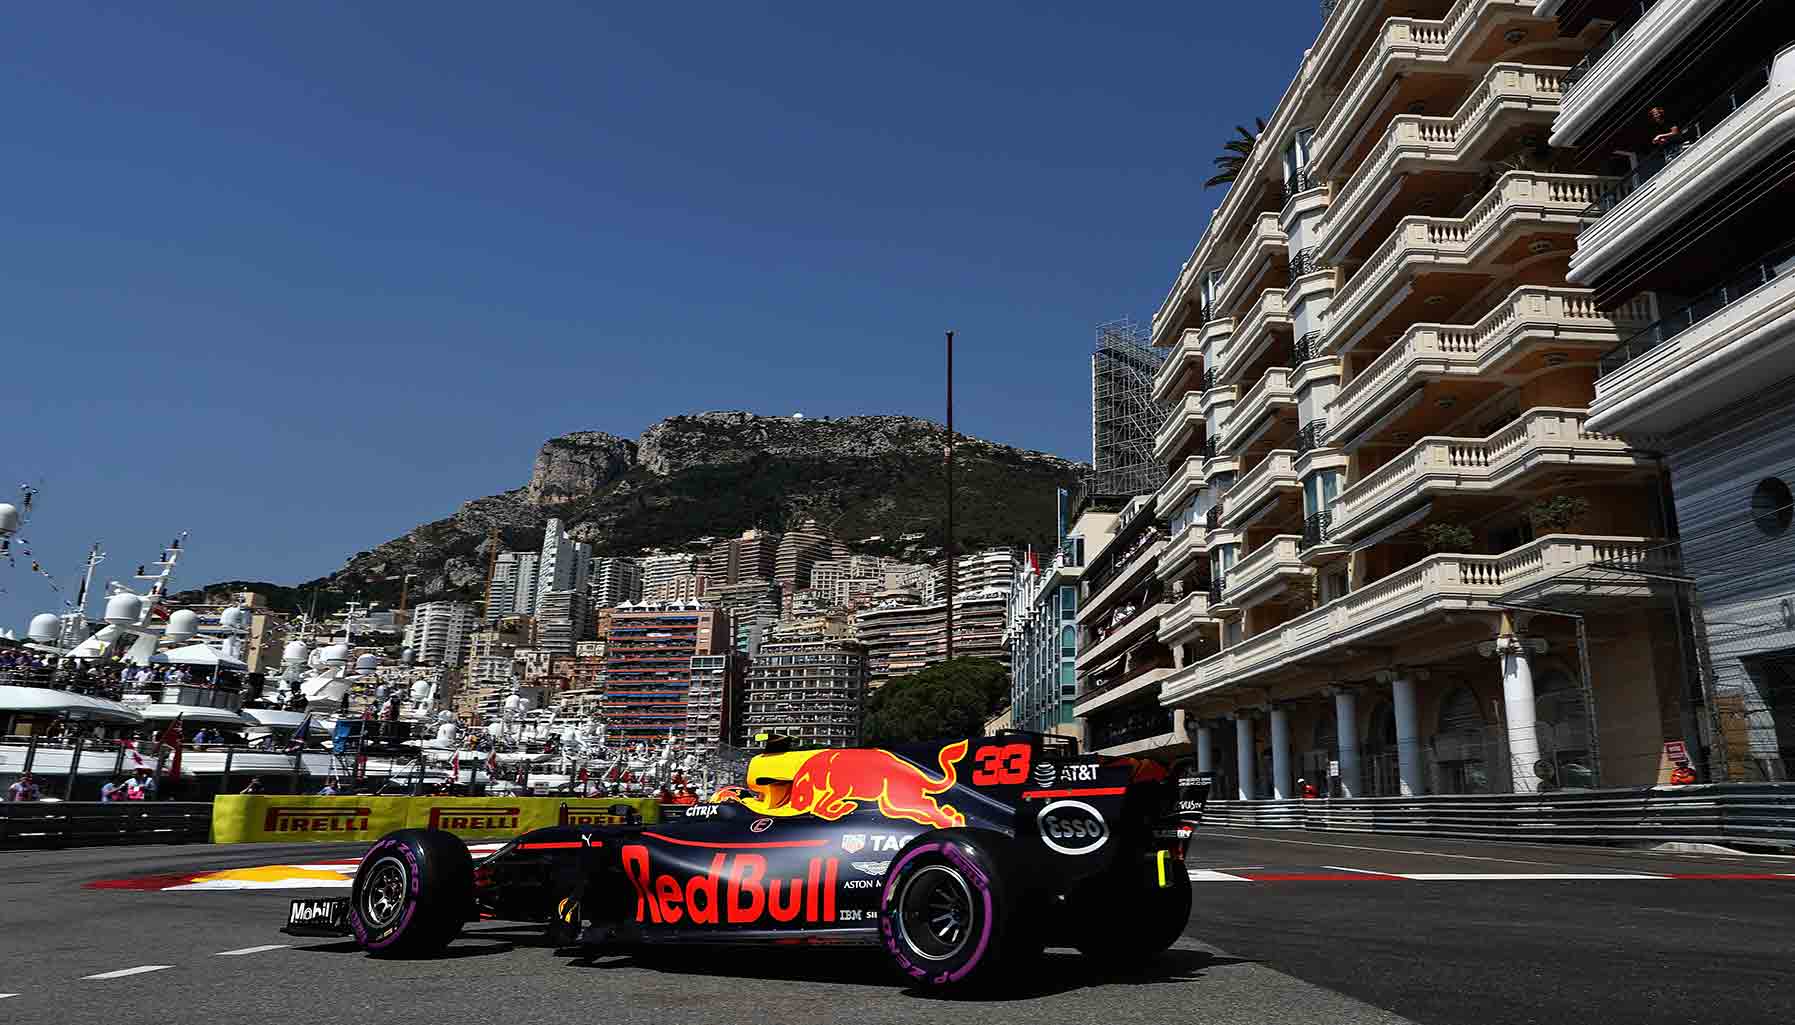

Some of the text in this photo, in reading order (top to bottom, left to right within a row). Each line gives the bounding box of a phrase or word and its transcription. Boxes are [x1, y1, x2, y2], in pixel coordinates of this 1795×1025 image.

[973, 744, 1031, 785] 33
[1061, 764, 1100, 781] AT&T
[264, 807, 371, 832] PIRELLI
[430, 807, 520, 832] PIRELLI
[621, 845, 839, 924] Red Bull
[844, 880, 873, 889] ASTON
[290, 902, 331, 923] Mobil
[840, 910, 862, 921] IBM
